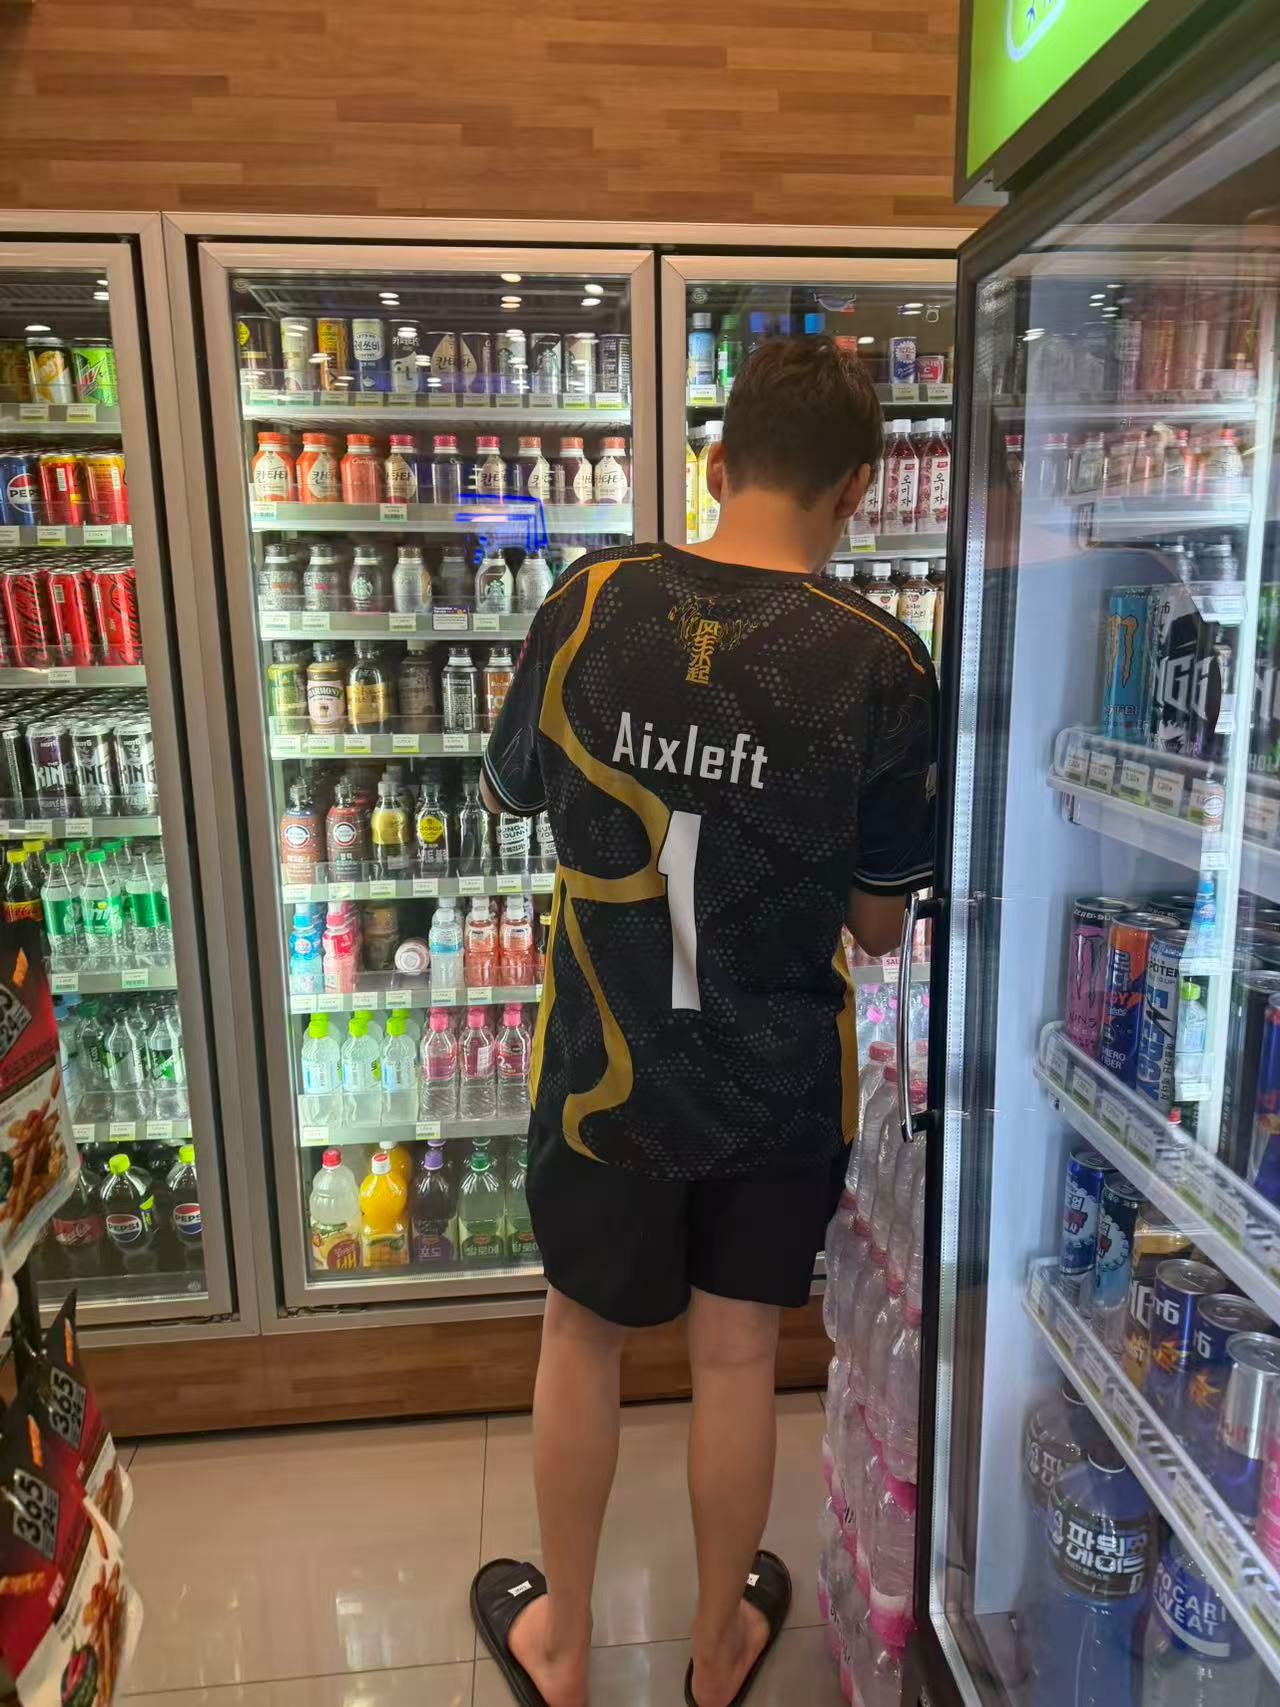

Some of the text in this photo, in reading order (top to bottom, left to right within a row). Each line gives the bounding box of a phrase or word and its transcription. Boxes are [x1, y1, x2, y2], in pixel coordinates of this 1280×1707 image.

[354, 341, 381, 352] 레쓰비
[900, 474, 912, 507] 오미자
[933, 472, 945, 505] 오미자
[612, 711, 768, 790] Aixleft
[658, 811, 702, 1011] 1
[175, 1214, 201, 1223] PEPS
[51, 1372, 74, 1435] 365
[16, 1473, 44, 1546] 365
[1067, 1519, 1126, 1557] 파워
